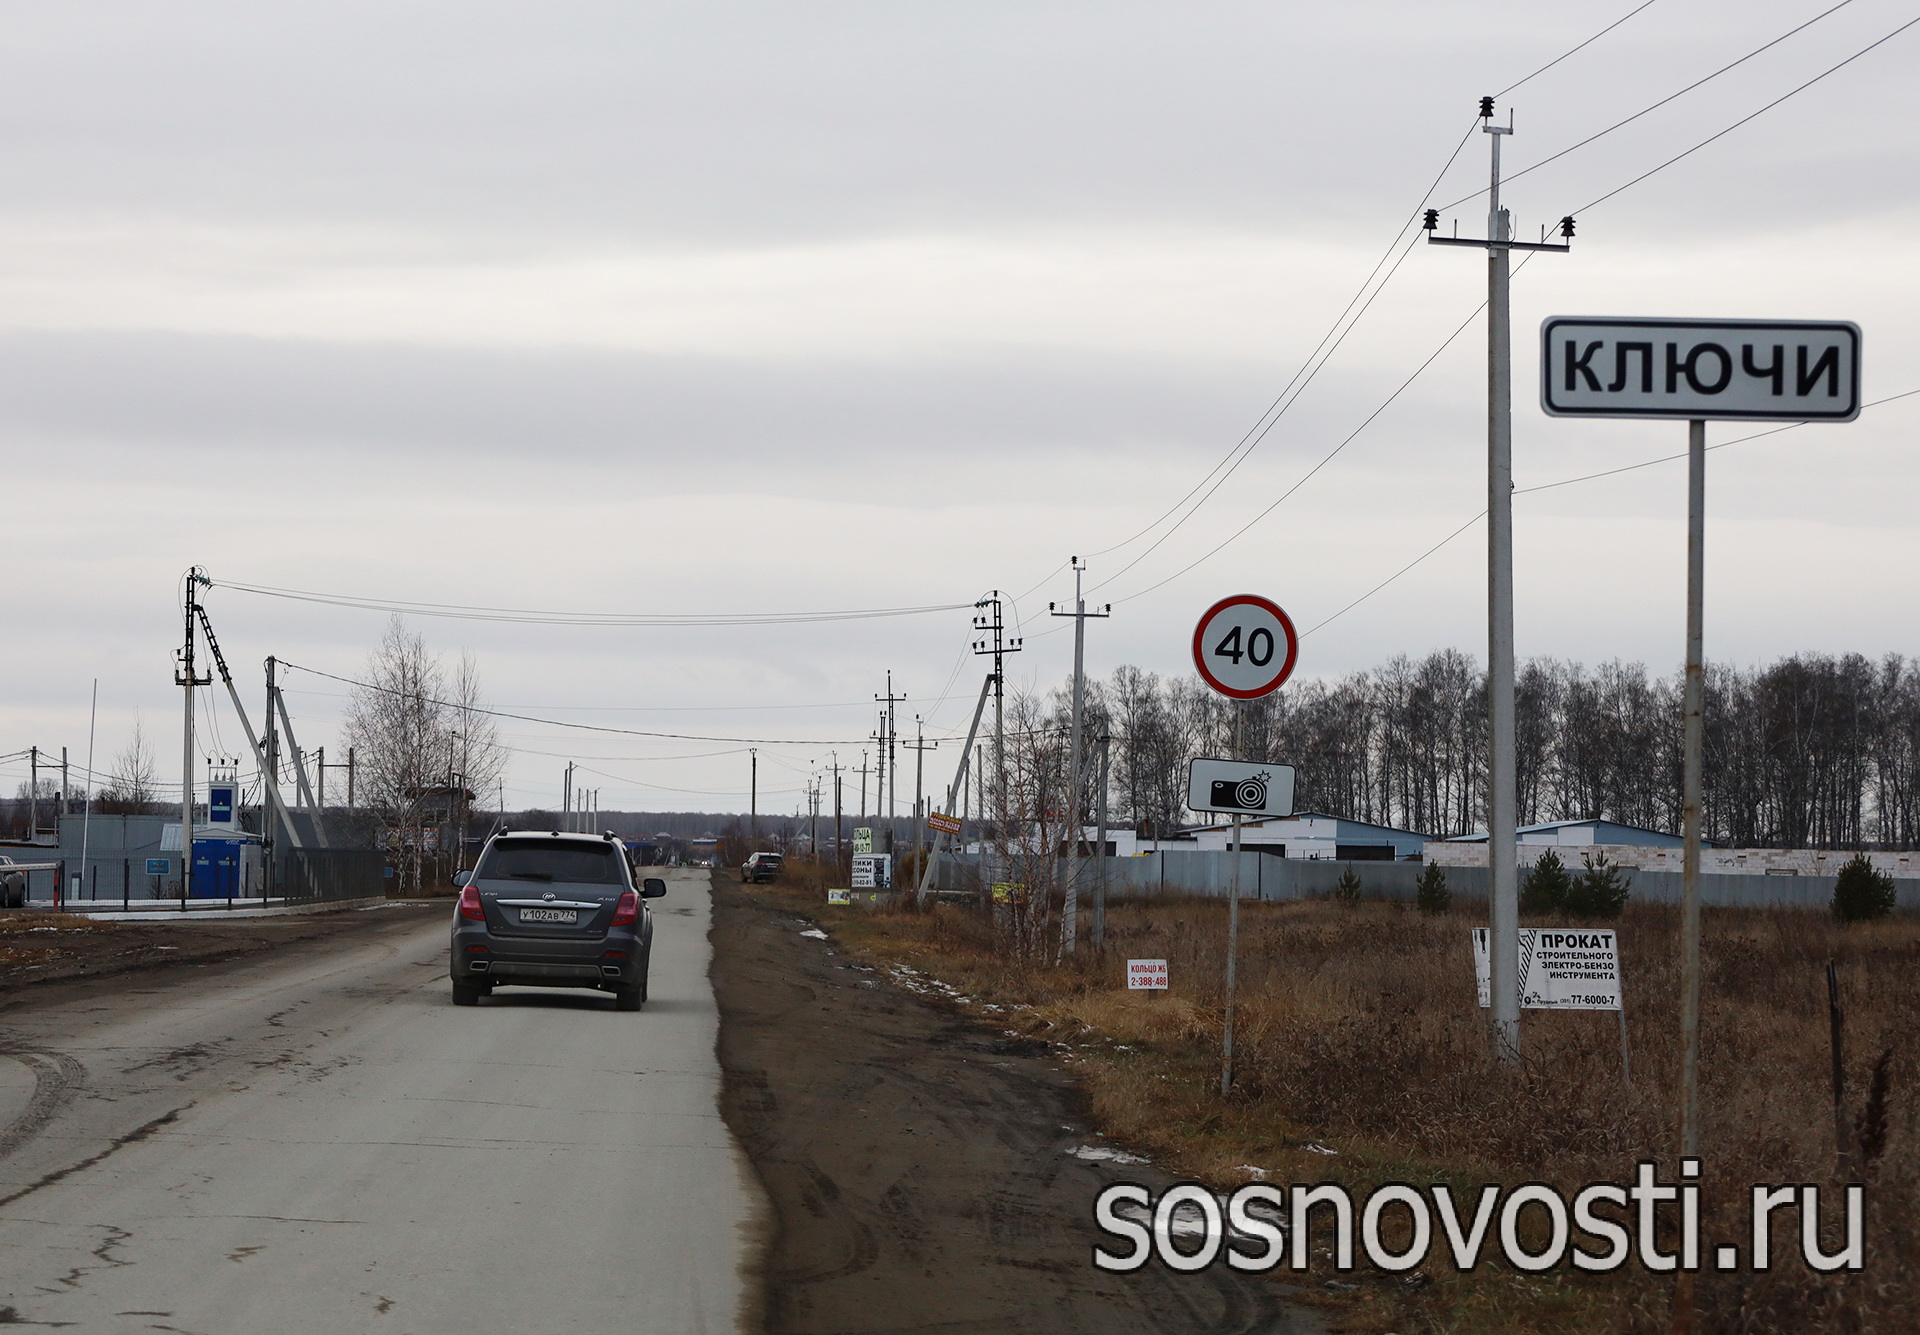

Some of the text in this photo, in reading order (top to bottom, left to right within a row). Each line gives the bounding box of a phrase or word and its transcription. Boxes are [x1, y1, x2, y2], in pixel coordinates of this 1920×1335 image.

[1565, 340, 1840, 397] КЛЮЧИ
[1214, 626, 1274, 667] 40
[1541, 934, 1612, 949] ПРОКАТ
[1536, 951, 1613, 960] СТРОИТЕЛЬНОГО
[1131, 964, 1157, 973] КОЛЬЦО
[1542, 961, 1614, 970] ЭЛЕКТРО-БЕНЗО
[1550, 971, 1615, 980] ИНСТРУМЕНТА
[1131, 976, 1166, 986] 2-388-488
[1571, 994, 1615, 1005] 77-6000-7
